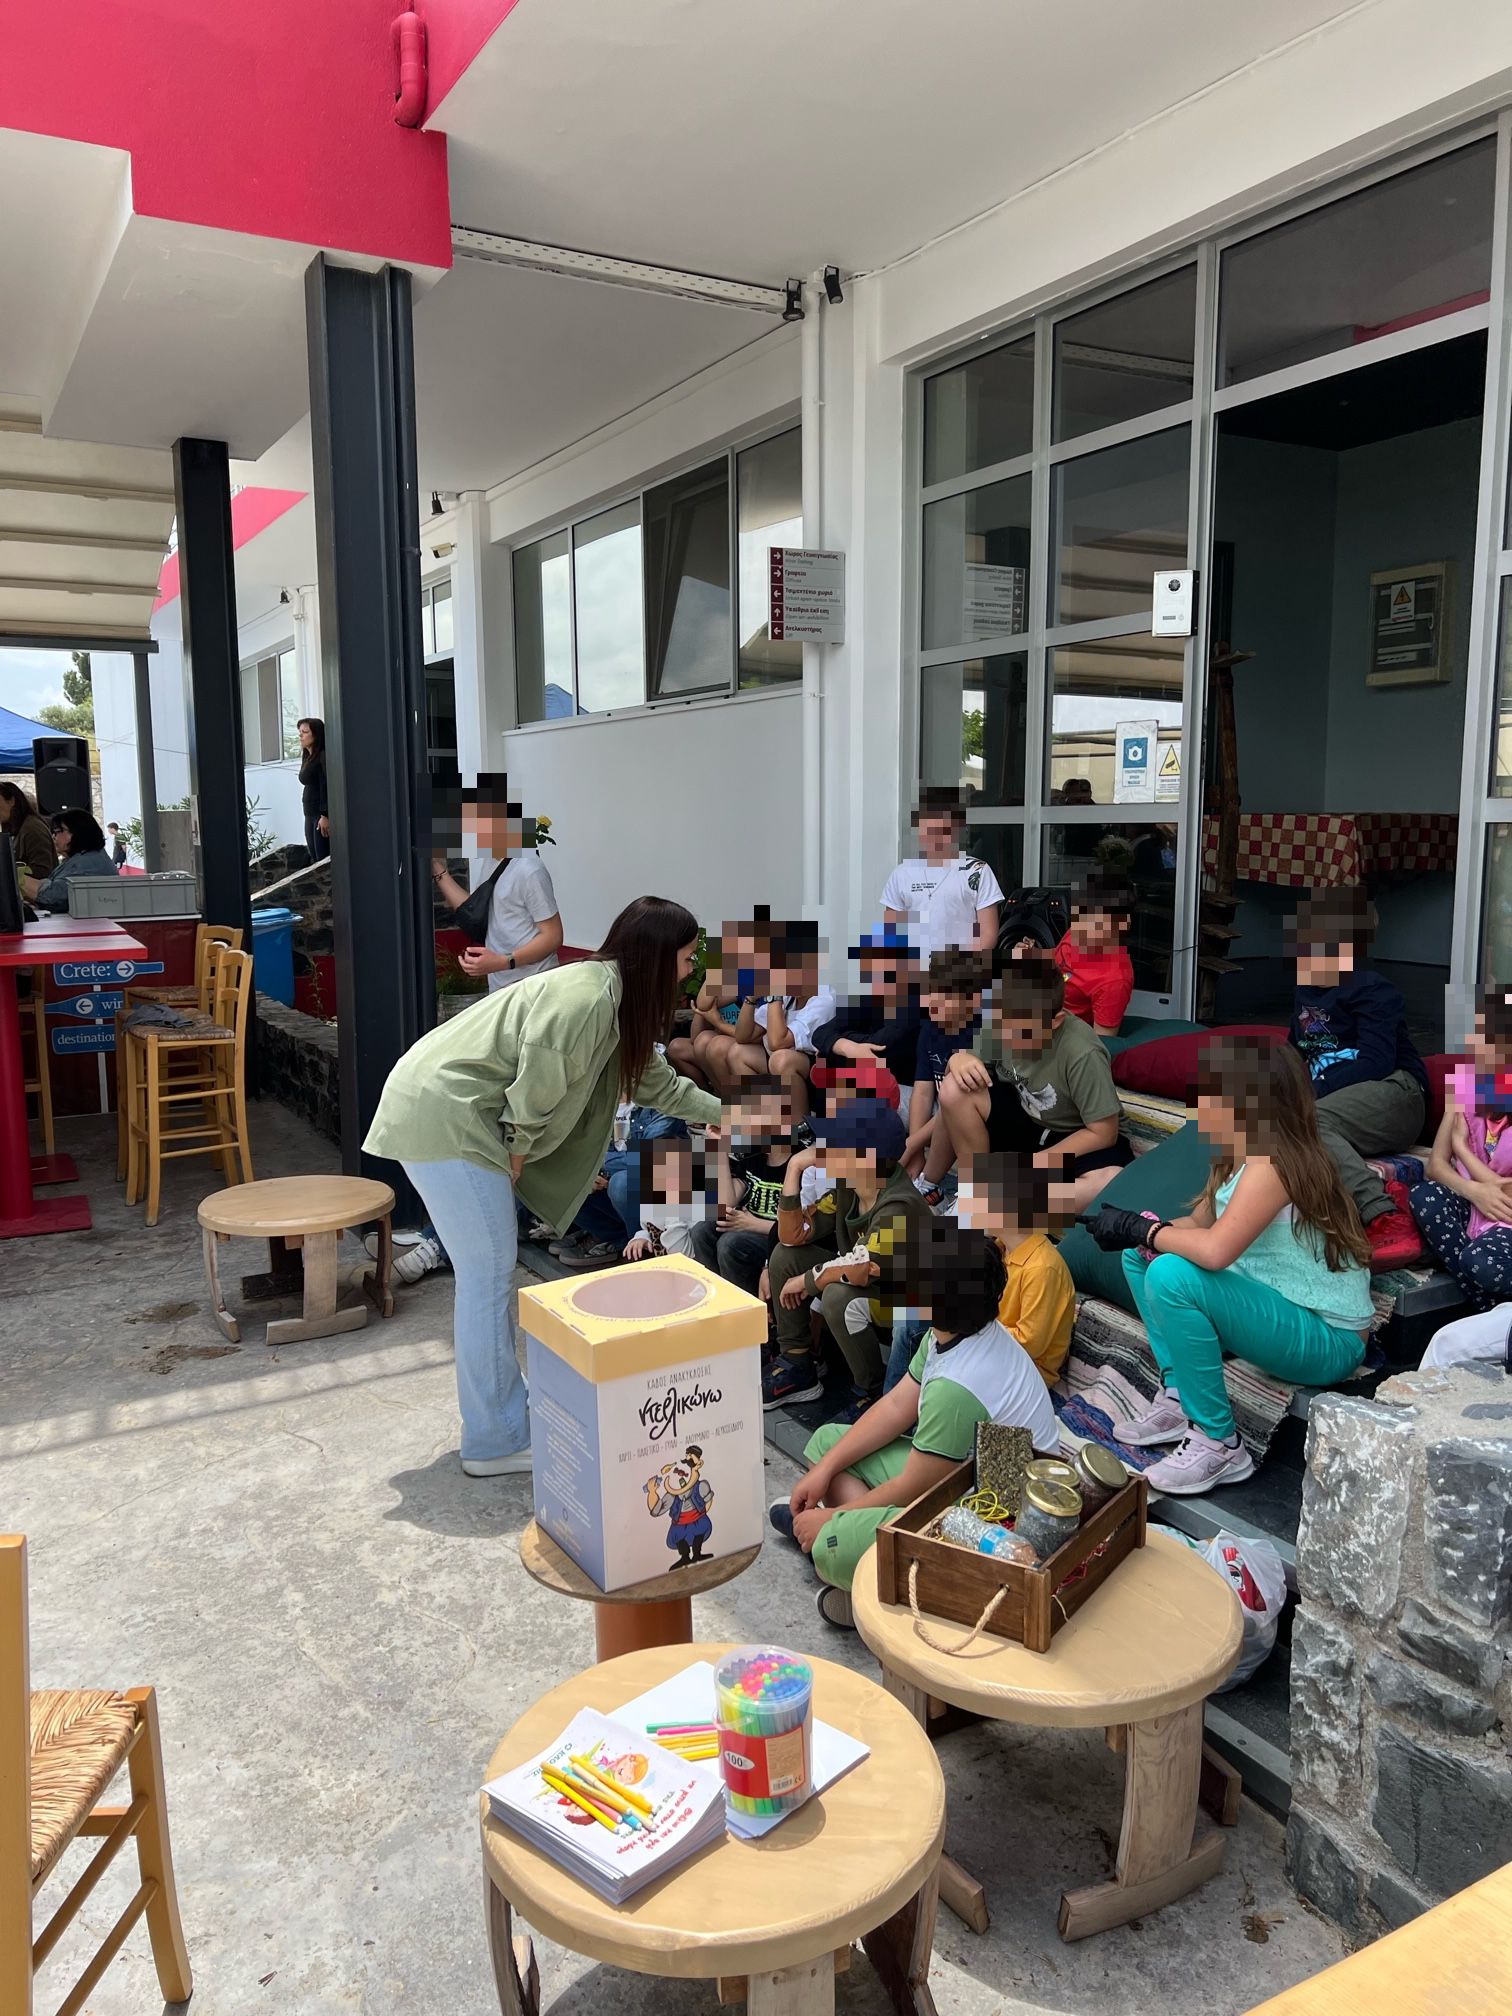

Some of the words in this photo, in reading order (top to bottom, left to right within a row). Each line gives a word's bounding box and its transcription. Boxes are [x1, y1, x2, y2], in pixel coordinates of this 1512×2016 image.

[60, 963, 111, 979] Crete:
[57, 1031, 115, 1045] destinatio
[647, 1375, 667, 1390] ΚΑΔΟΣ
[669, 1364, 712, 1385] ΑΝΑΚΥΚΛΩΣΗΣ
[727, 1752, 743, 1767] 100
